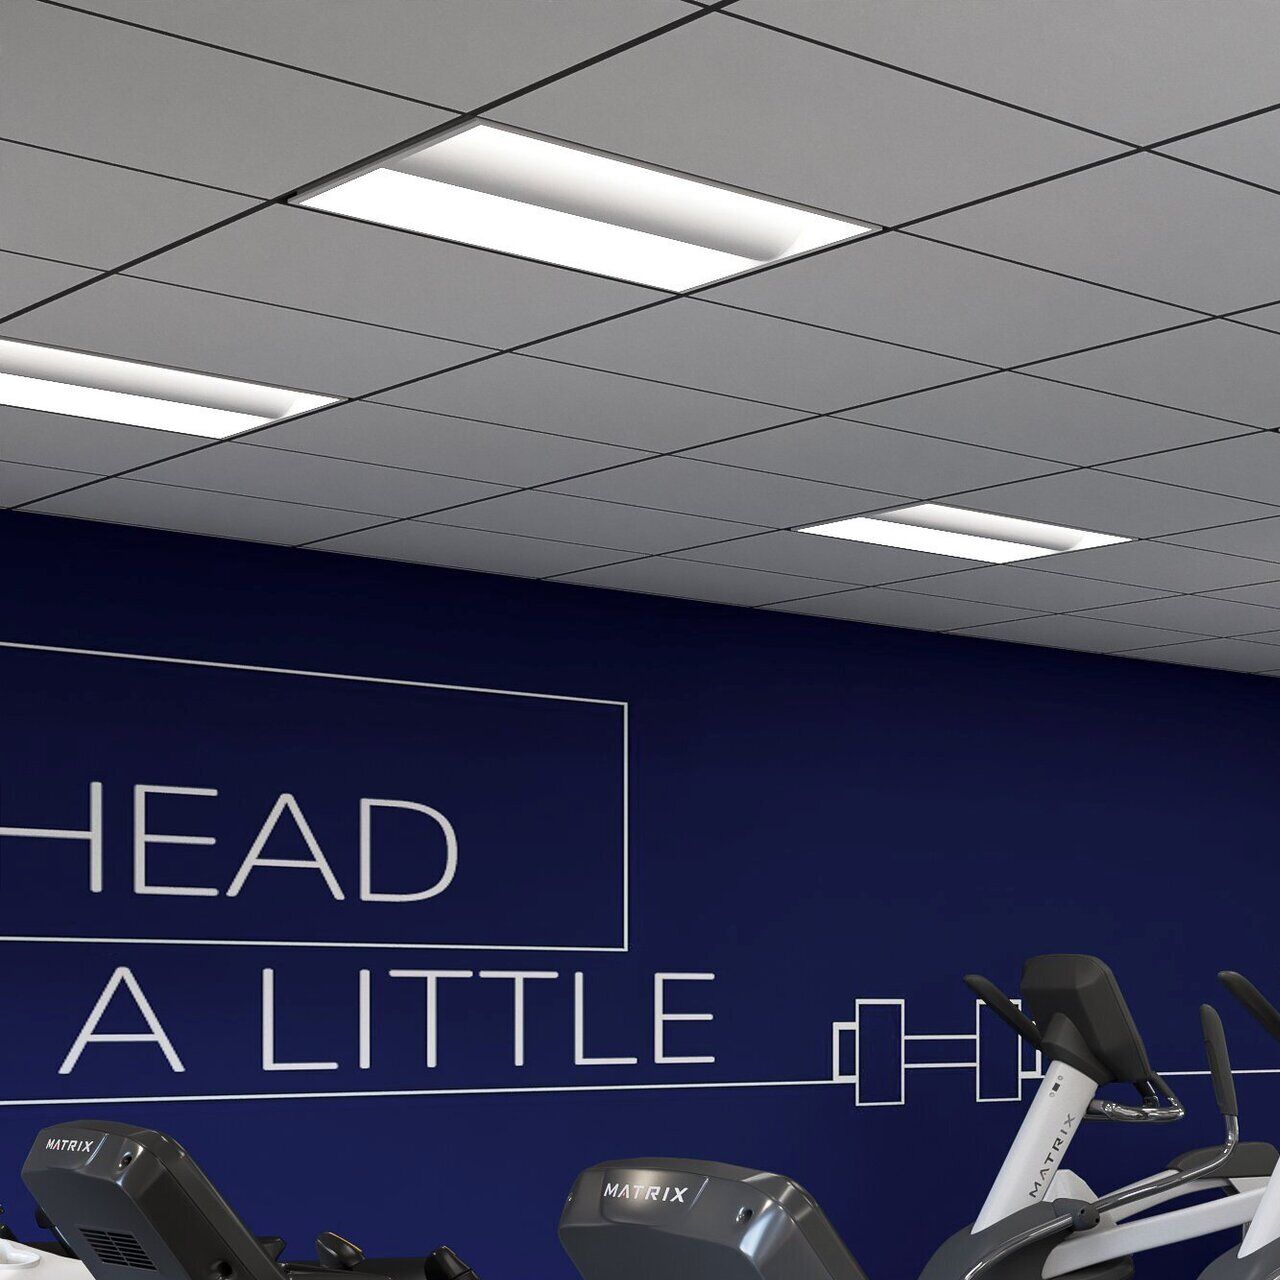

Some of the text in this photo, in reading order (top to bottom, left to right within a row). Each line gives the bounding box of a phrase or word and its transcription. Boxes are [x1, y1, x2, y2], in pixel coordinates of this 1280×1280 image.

[59, 966, 716, 1075] A LITTLE
[45, 1138, 94, 1153] MATRIX
[1029, 1113, 1076, 1198] MATRIX
[603, 1182, 689, 1203] MATRIX
